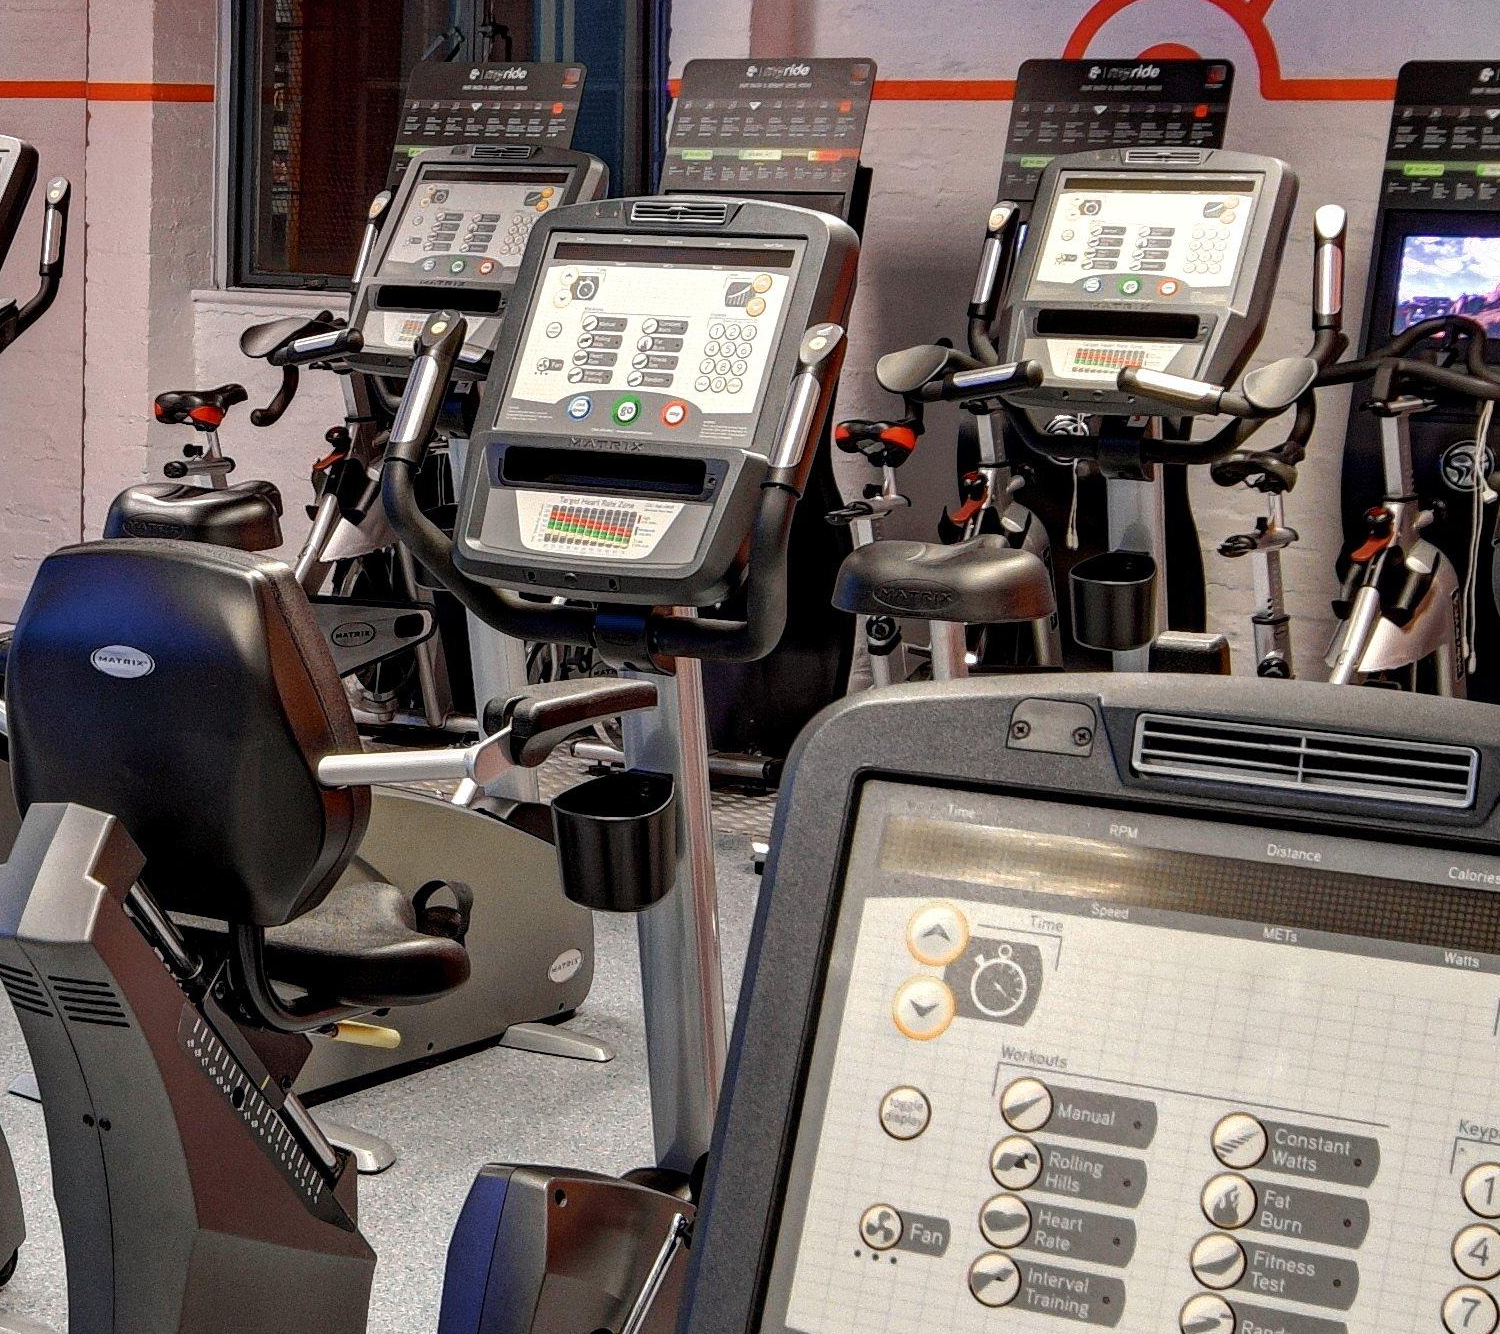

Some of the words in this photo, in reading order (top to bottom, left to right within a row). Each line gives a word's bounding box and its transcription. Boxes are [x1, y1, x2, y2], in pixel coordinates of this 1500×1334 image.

[567, 436, 646, 453] MATRIX
[878, 584, 955, 605] MATRIX
[335, 628, 371, 640] MATRIX
[98, 653, 149, 669] MATRIX
[947, 803, 978, 821] Time
[1109, 824, 1139, 840] RPM
[1267, 843, 1322, 863] Distance
[1030, 915, 1064, 933] Time
[1092, 903, 1130, 921] Speed
[1262, 926, 1298, 944] METs
[1443, 951, 1481, 969] Watts
[1001, 1044, 1068, 1069] Workouts
[1057, 1102, 1116, 1127] Manual
[1274, 1128, 1351, 1155] Constant
[1050, 1152, 1104, 1177] Rolling
[1272, 1150, 1317, 1172] Watts
[1045, 1172, 1080, 1193] Hills
[1484, 1177, 1495, 1205] 1
[1263, 1190, 1291, 1210] Fat
[1038, 1209, 1083, 1232] Heart
[1260, 1211, 1303, 1235] Burn
[909, 1223, 943, 1246] Fan
[1035, 1231, 1071, 1251] Rate
[1253, 1250, 1316, 1278] Fitness
[1467, 1238, 1490, 1267] 4
[1027, 1268, 1090, 1294] Interval
[1250, 1271, 1285, 1293] Test
[1026, 1287, 1090, 1319] Training
[1461, 1297, 1482, 1328] 7
